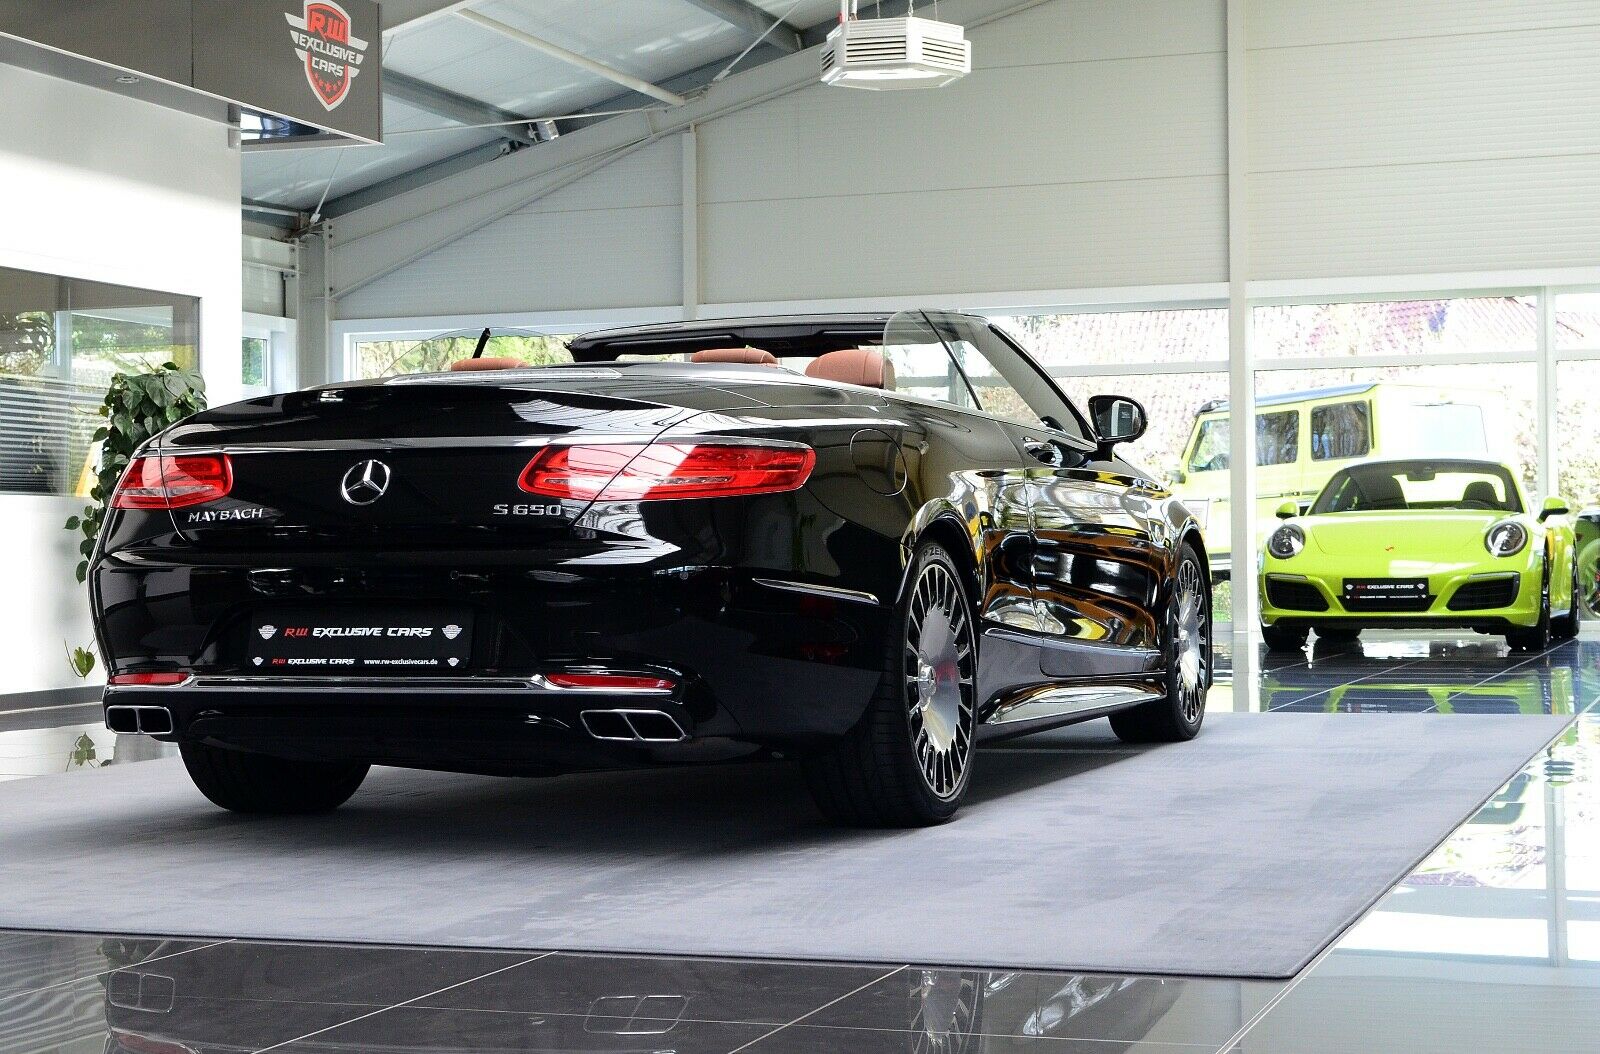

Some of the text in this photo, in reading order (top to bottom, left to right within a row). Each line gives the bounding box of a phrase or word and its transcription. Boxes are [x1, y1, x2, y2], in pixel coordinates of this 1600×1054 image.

[308, 11, 346, 42] RW
[299, 33, 355, 64] EXCLUSIVE
[311, 57, 344, 77] CARS
[187, 508, 264, 523] MAYBACH
[493, 504, 562, 516] S 650
[284, 627, 434, 639] RW EXCLUSIVE CARS
[287, 658, 328, 666] EXCLUSIVE
[329, 658, 355, 666] CARS
[363, 658, 439, 666] www.rw-exclusivecars.de
